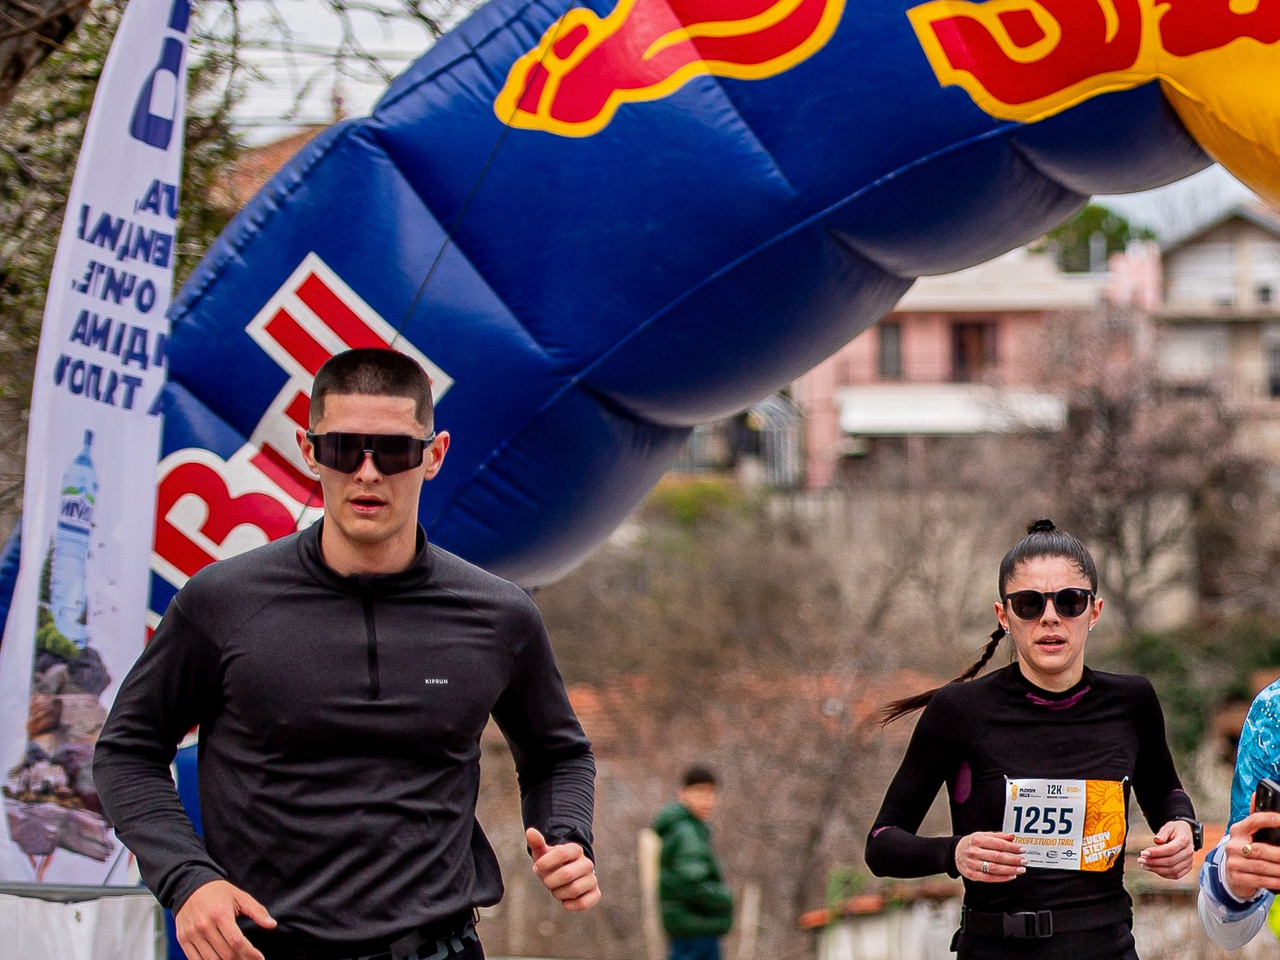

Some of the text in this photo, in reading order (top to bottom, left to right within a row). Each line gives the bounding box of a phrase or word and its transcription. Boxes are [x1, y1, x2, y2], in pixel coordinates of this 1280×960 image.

[1046, 784, 1062, 795] 12K
[1013, 806, 1074, 835] 1255
[1083, 841, 1106, 855] STEP
